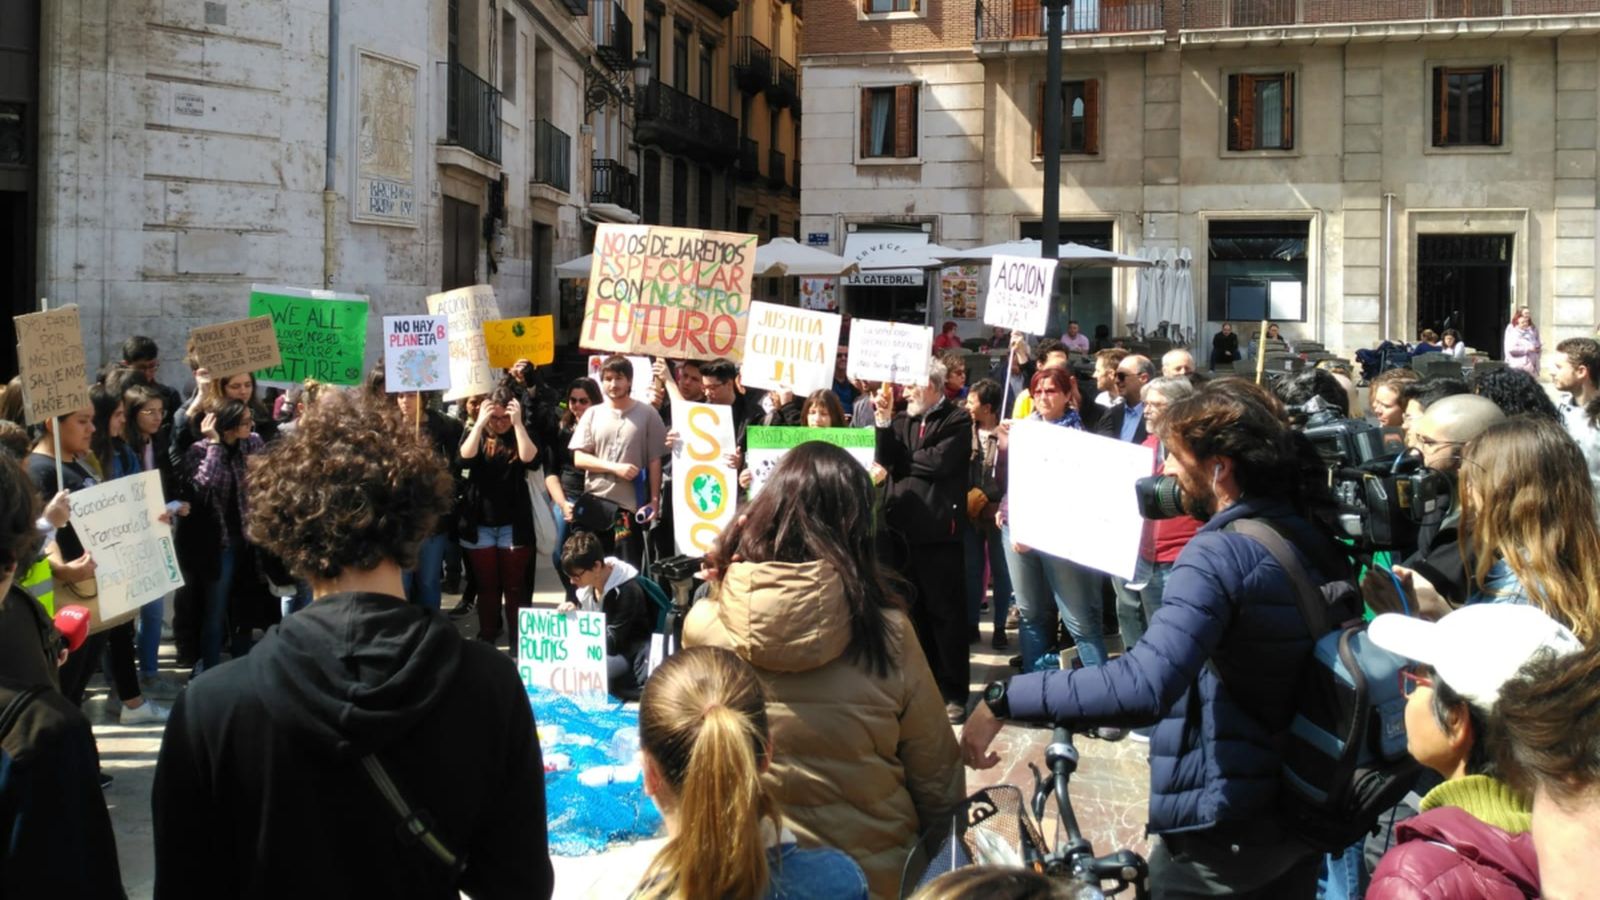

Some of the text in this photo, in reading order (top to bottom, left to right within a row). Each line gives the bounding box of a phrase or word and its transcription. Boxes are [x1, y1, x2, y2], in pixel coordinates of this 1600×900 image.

[602, 233, 747, 265] NO OS DEJAREMOS
[599, 255, 745, 293] ESPECULAR
[848, 275, 915, 284] LA CATEDRAL
[994, 261, 1047, 298] ACCION
[597, 277, 743, 315] CON NUESTRO
[268, 303, 344, 329] WE ALL
[394, 320, 410, 333] NO
[413, 319, 435, 332] HAY
[588, 298, 738, 356] FUTURO
[757, 310, 822, 335] JUSTICIA
[389, 332, 437, 348] PLANETA
[436, 325, 445, 340] B
[578, 613, 601, 637] ELS
[587, 644, 603, 661] NO
